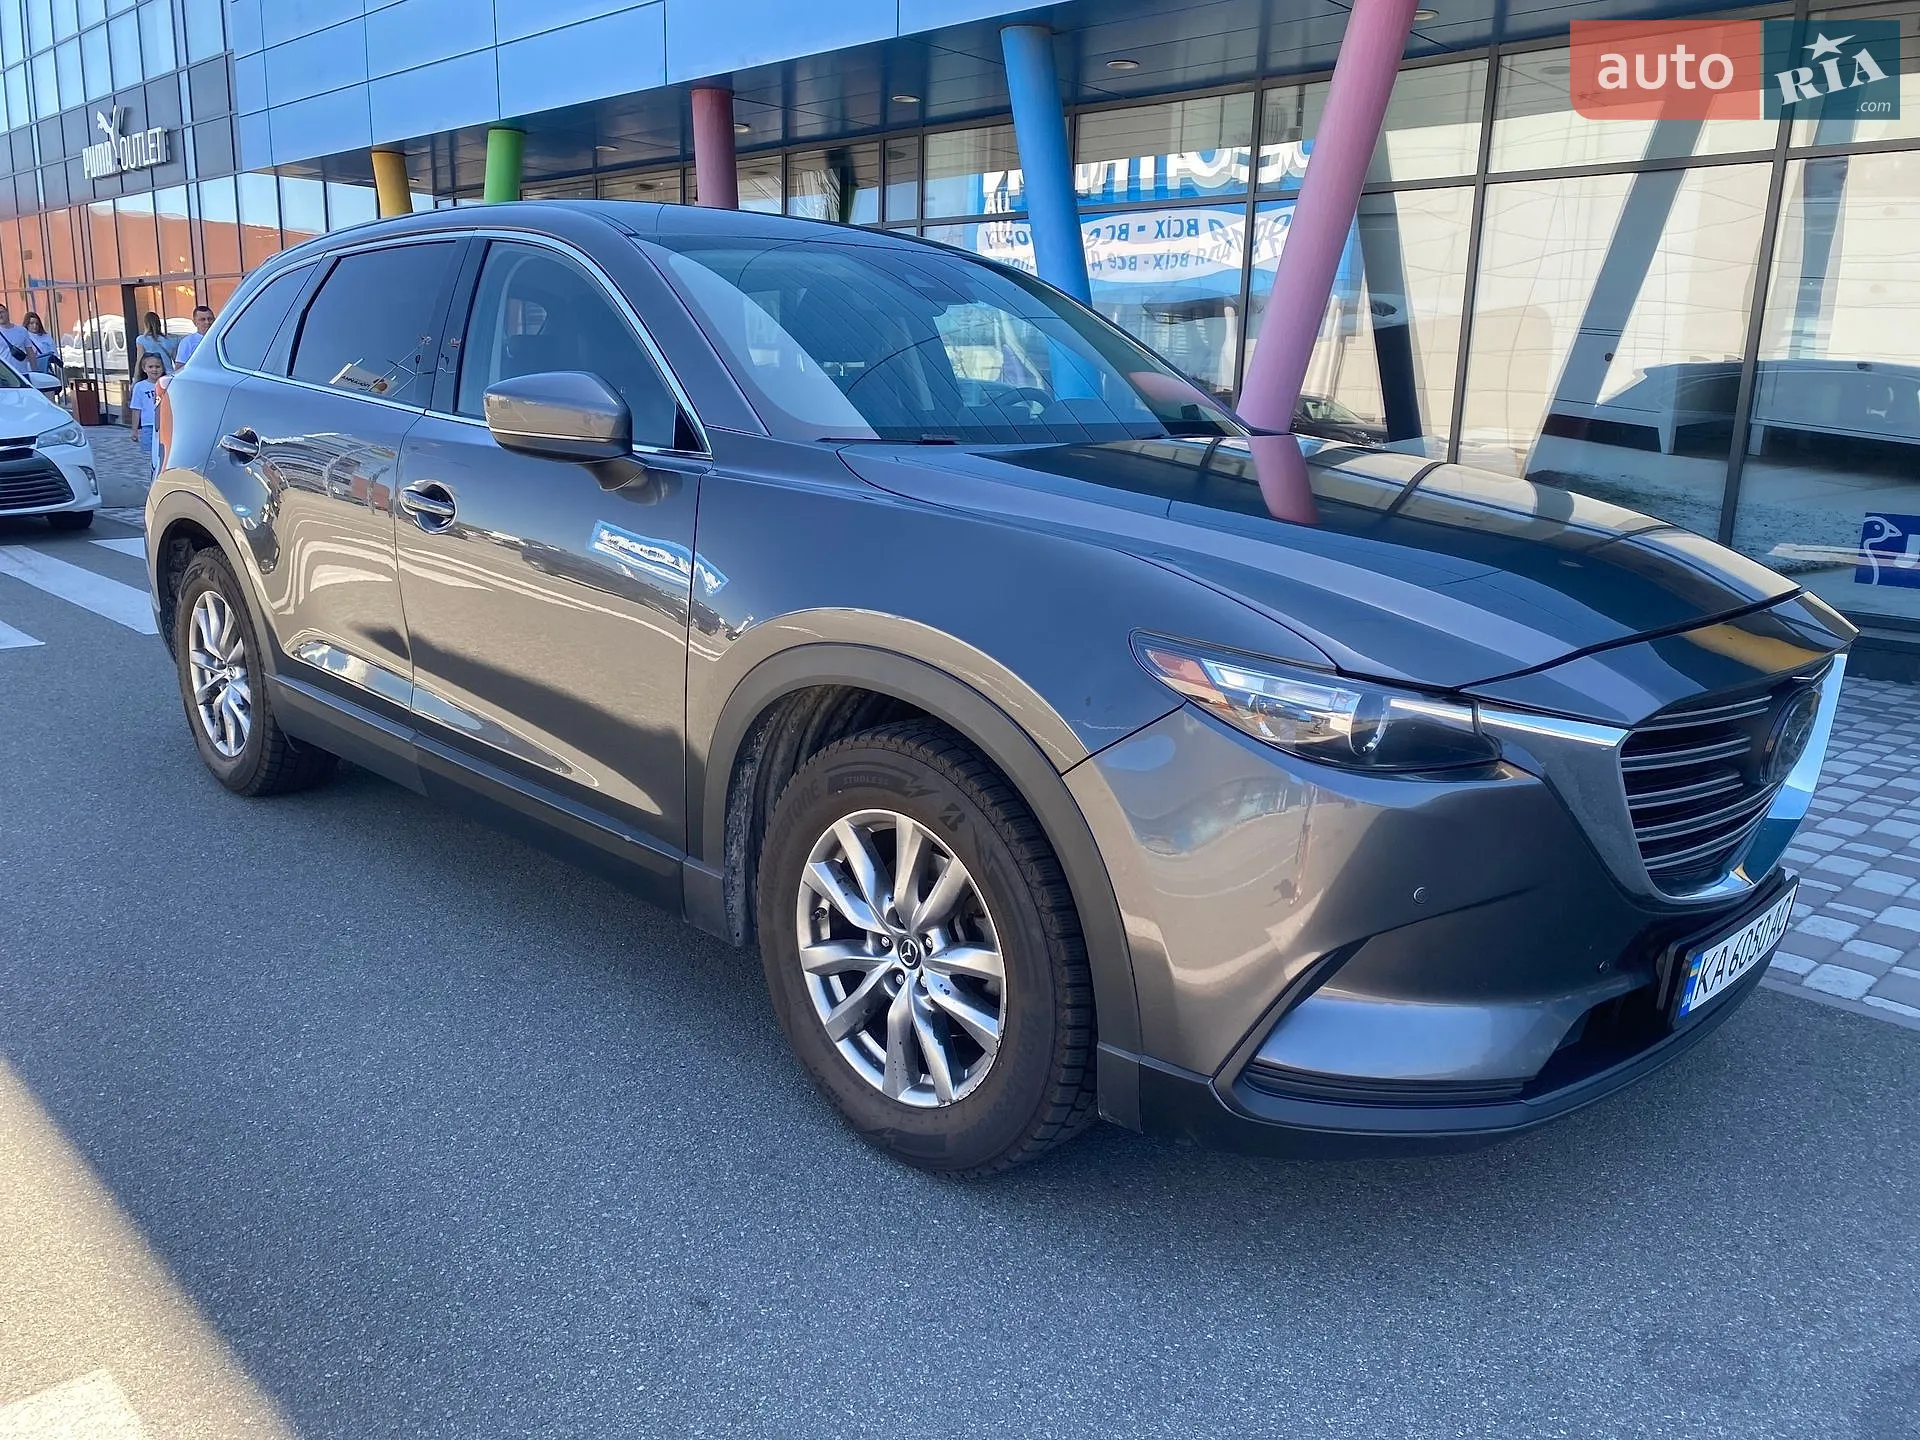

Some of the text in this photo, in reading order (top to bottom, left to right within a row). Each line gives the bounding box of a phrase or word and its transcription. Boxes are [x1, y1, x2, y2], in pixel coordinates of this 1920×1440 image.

[82, 126, 165, 180] PUMA OUTLET
[1693, 945, 1729, 1001] KA
[1728, 914, 1772, 977] 6050
